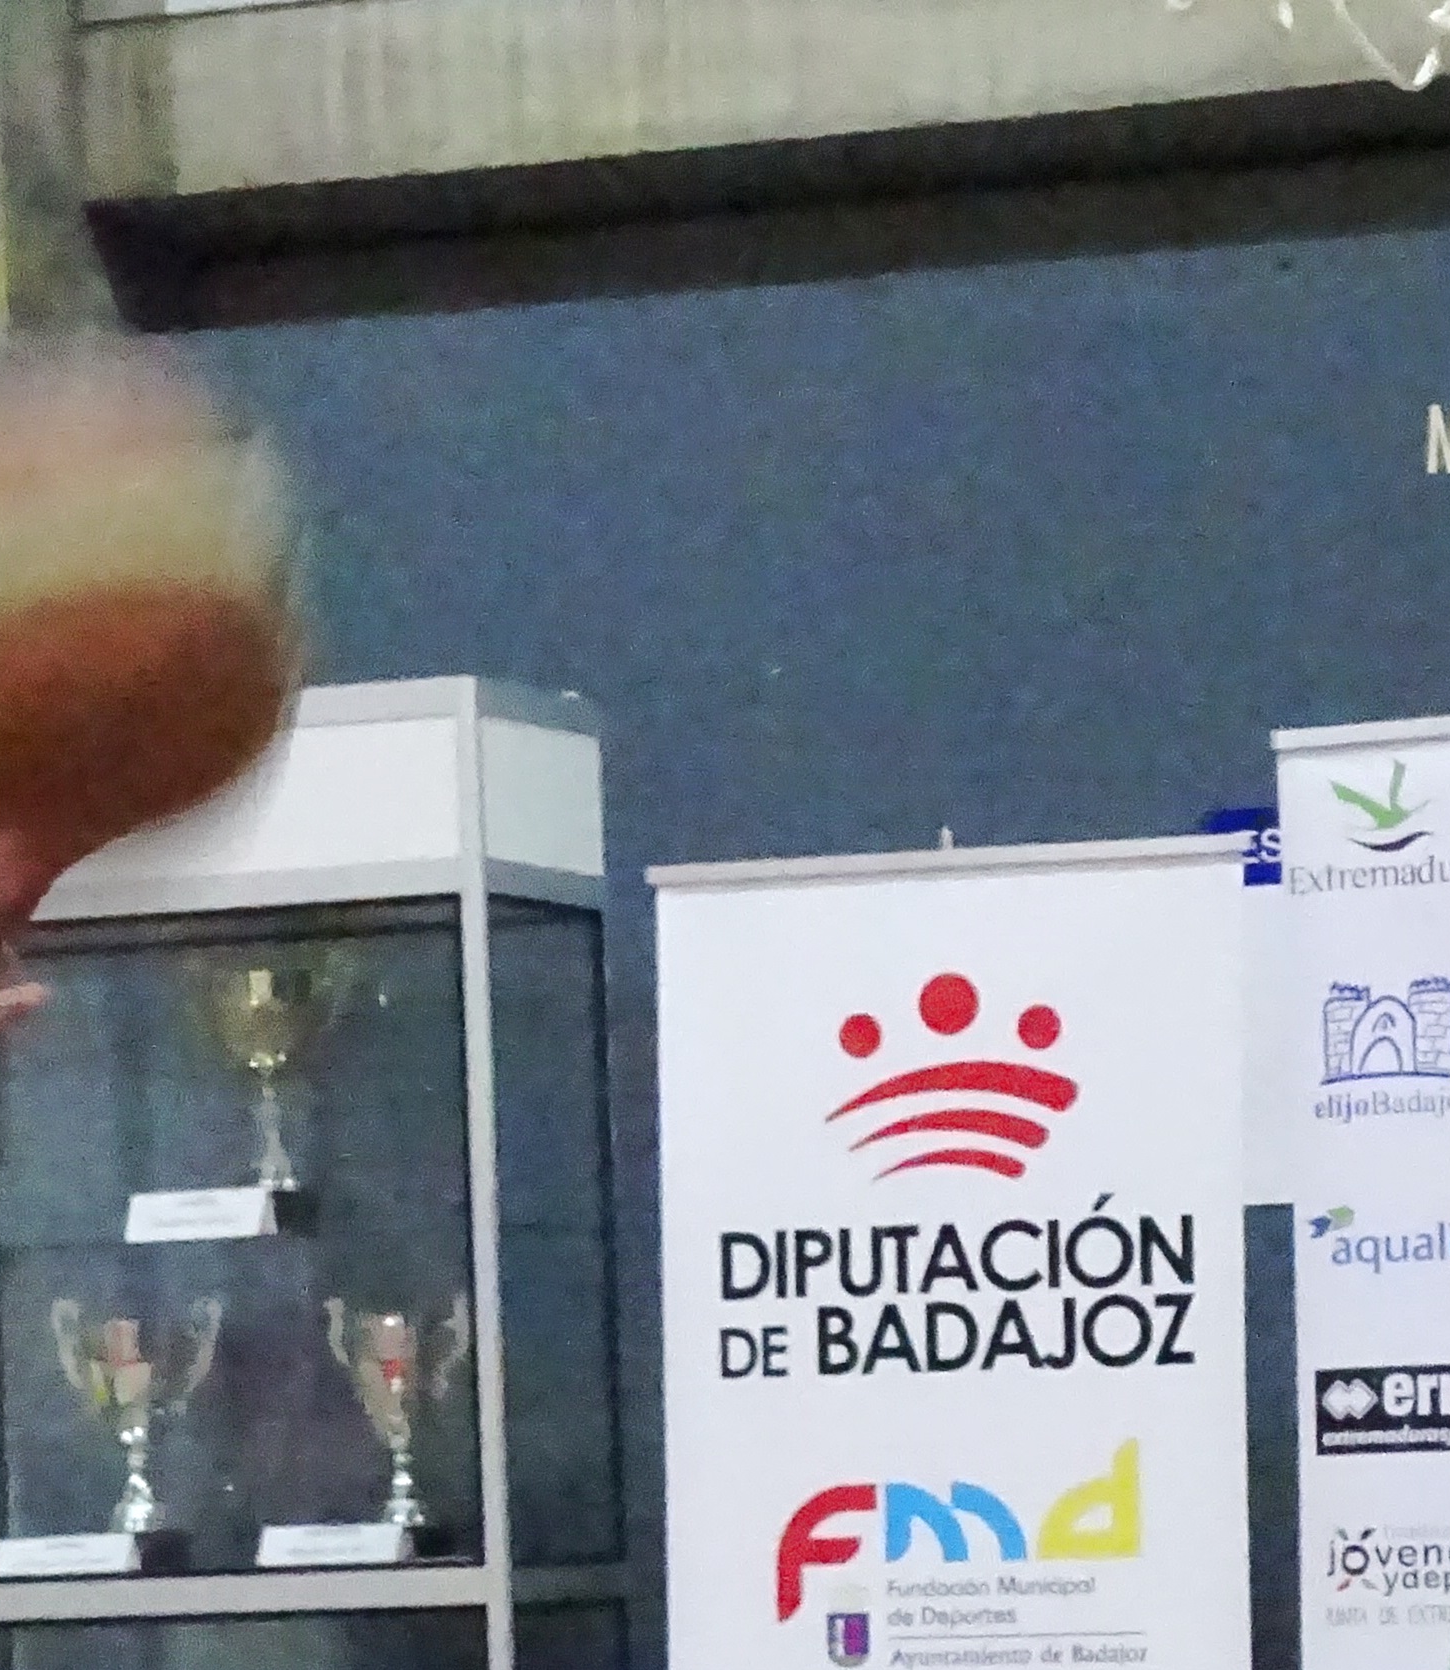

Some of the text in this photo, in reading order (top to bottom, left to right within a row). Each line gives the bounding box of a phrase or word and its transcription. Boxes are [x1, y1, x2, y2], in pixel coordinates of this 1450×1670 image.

[720, 1193, 1196, 1301] DIPUTACIÓN
[720, 1293, 1197, 1379] DE BADAJOZ
[998, 1575, 1097, 1596] Municipal
[887, 1606, 1017, 1629] de Deportes
